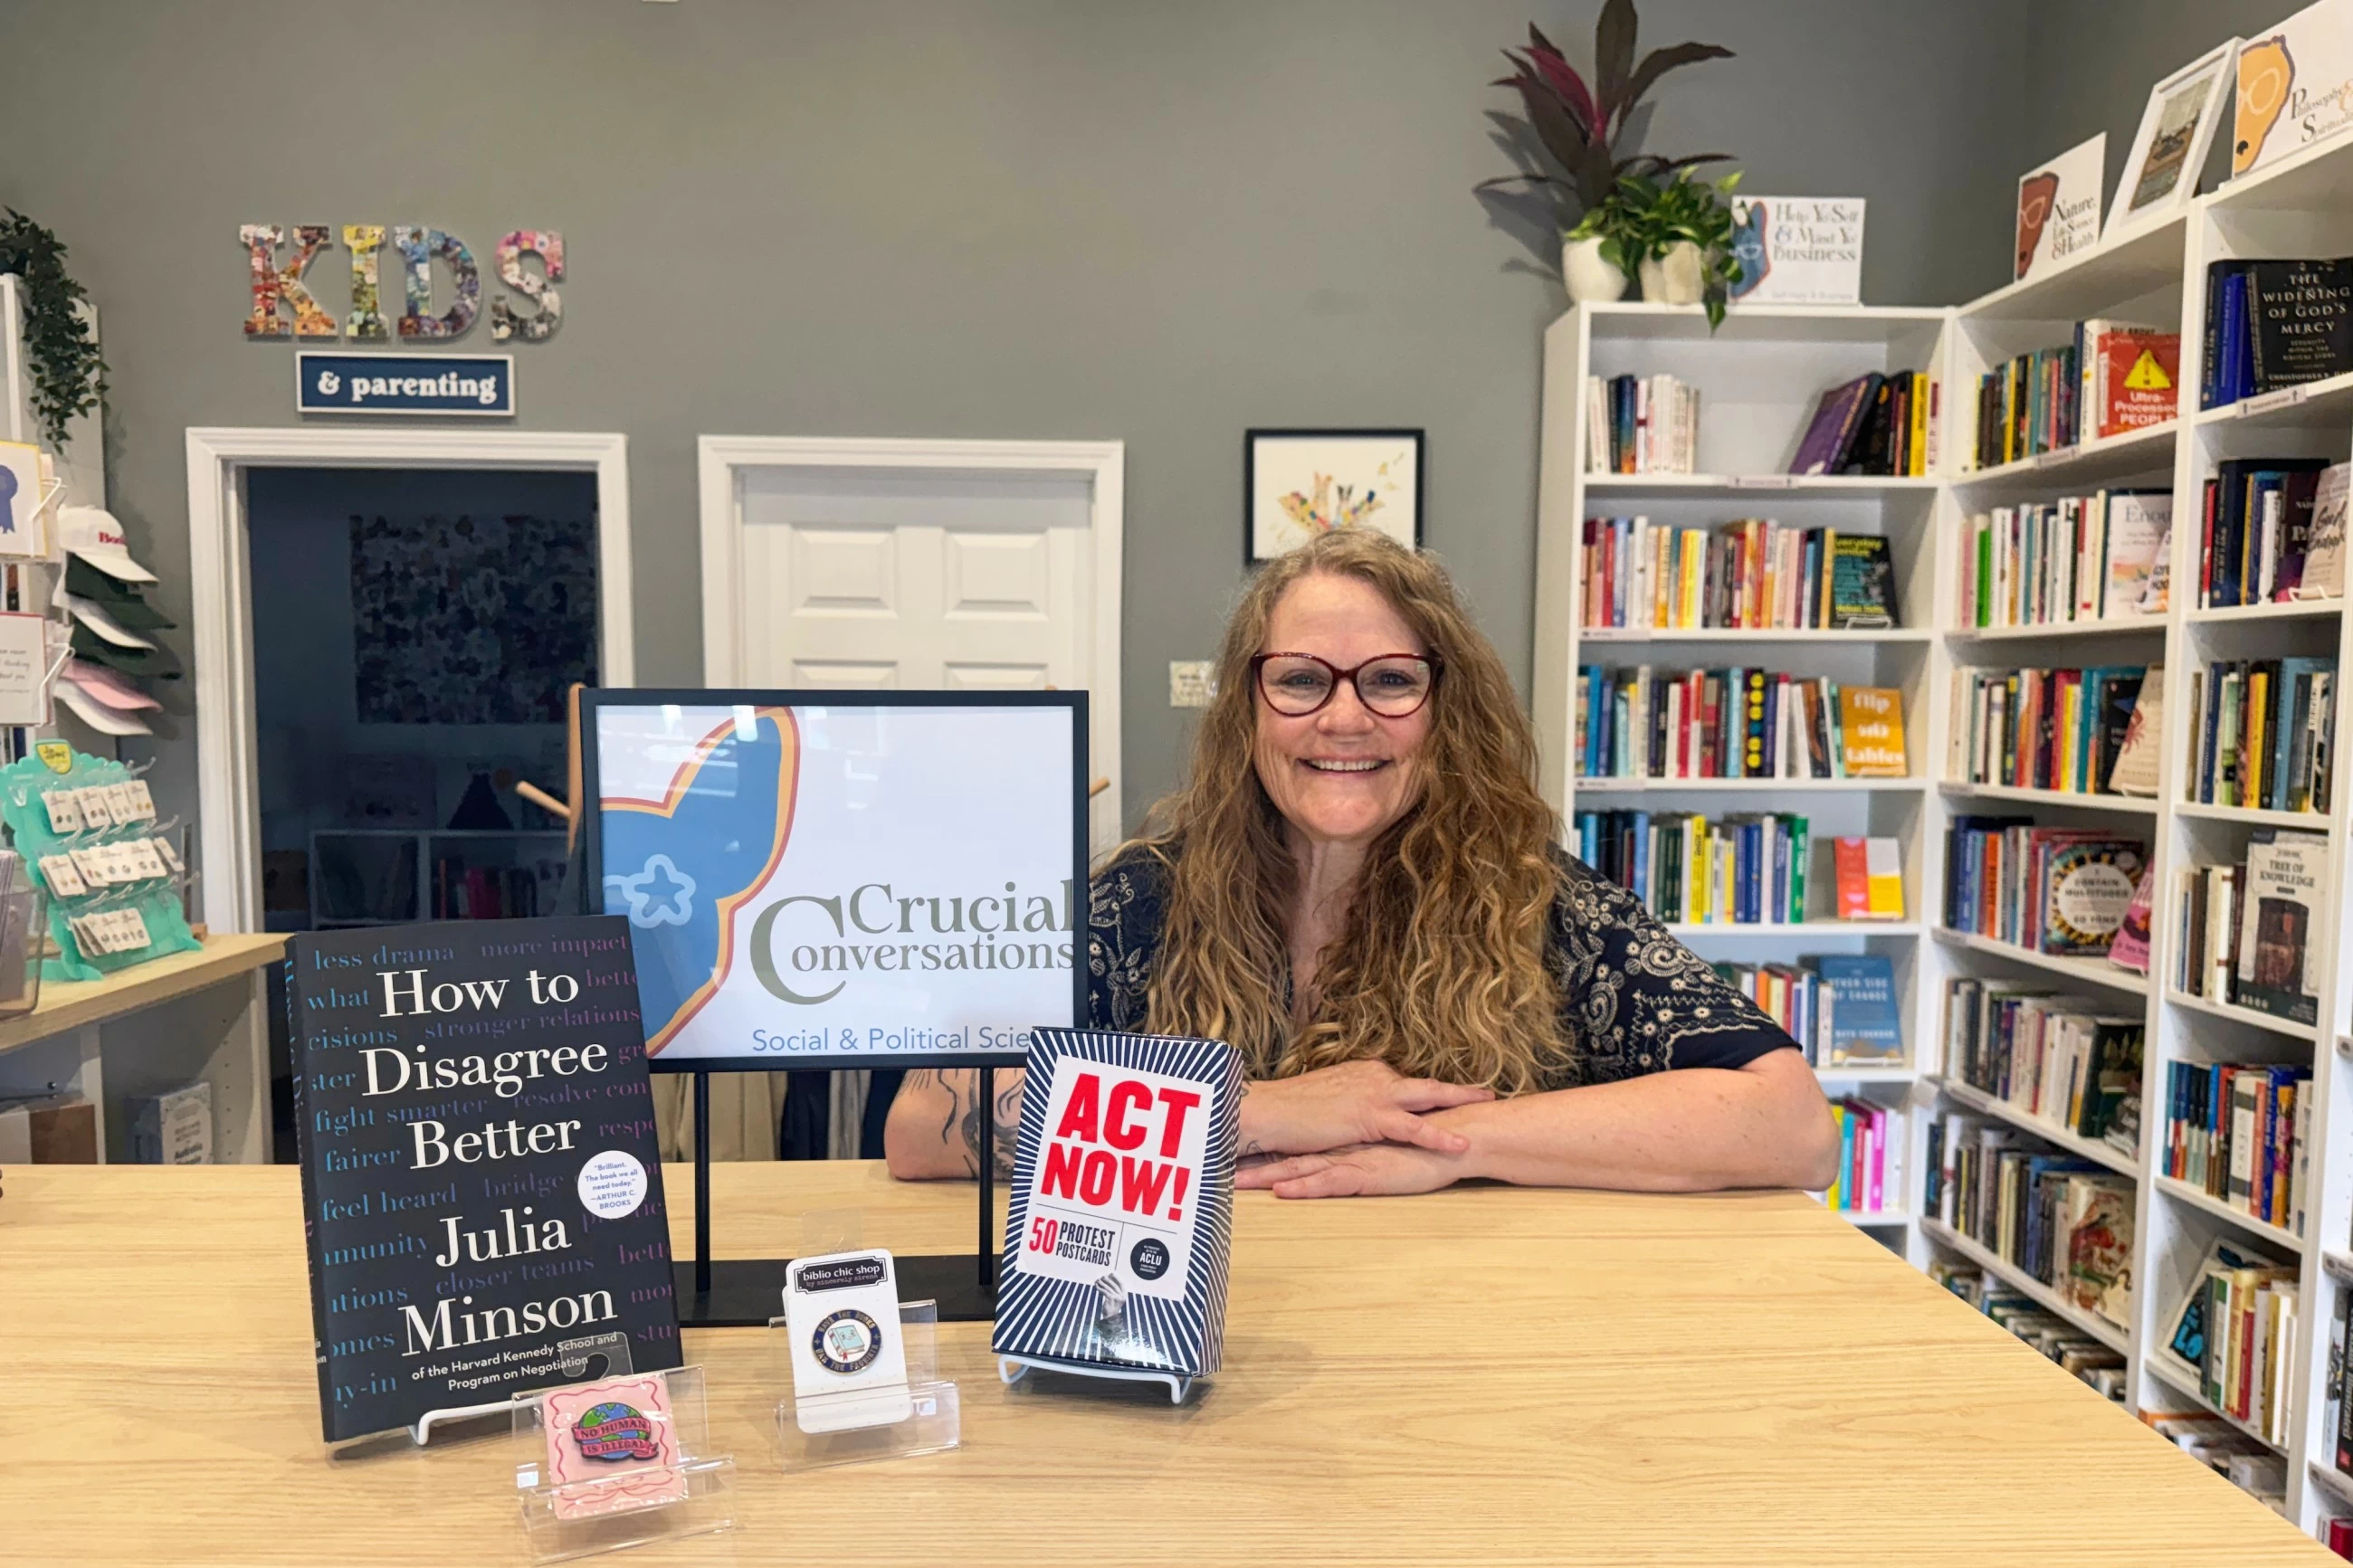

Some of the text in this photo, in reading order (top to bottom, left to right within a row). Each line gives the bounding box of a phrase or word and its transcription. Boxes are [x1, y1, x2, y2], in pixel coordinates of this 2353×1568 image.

[1774, 244, 1855, 261] Business
[240, 224, 566, 340] KIDS
[2262, 286, 2351, 302] WIDENING
[2289, 273, 2320, 285] THE
[2268, 308, 2288, 318] OF
[2281, 320, 2335, 335] MERCY
[318, 371, 498, 404] & parenting
[849, 880, 1074, 934] Crucial
[315, 935, 627, 971] less drama more impact
[750, 895, 1074, 1005] Conversations
[308, 988, 369, 1011] what
[376, 969, 579, 1017] How to
[424, 1017, 530, 1039] stronger
[752, 1025, 1030, 1052] Social & Political Scie
[358, 1042, 607, 1098] Disagree
[316, 1107, 376, 1137] fight
[386, 1098, 488, 1124] smarter
[513, 1083, 597, 1108] resolve
[1056, 1072, 1201, 1159] ACT
[406, 1118, 581, 1170] Better
[326, 1149, 401, 1174] fairer
[599, 1172, 617, 1181] book
[592, 1183, 610, 1192] need
[1041, 1142, 1190, 1221] NOW!
[322, 1172, 563, 1222] feel heard bridge
[599, 1199, 632, 1210] BROOKS
[435, 1206, 572, 1268] Julia
[1029, 1217, 1115, 1255] 50 PROTEST
[1055, 1242, 1111, 1267] POSTCARDS
[1139, 1252, 1162, 1266] ACLU
[435, 1269, 512, 1297] closer
[522, 1257, 595, 1281] teams
[804, 1265, 880, 1281] biblio chic shop
[817, 1277, 853, 1285] sincerely
[397, 1288, 618, 1357] Minson
[412, 1332, 618, 1380] of the Harvard Kennedy School and
[448, 1355, 588, 1392] Program on Negotiation
[581, 1420, 646, 1438] NO HUMAN
[587, 1440, 645, 1453] IS ILLEGAL
